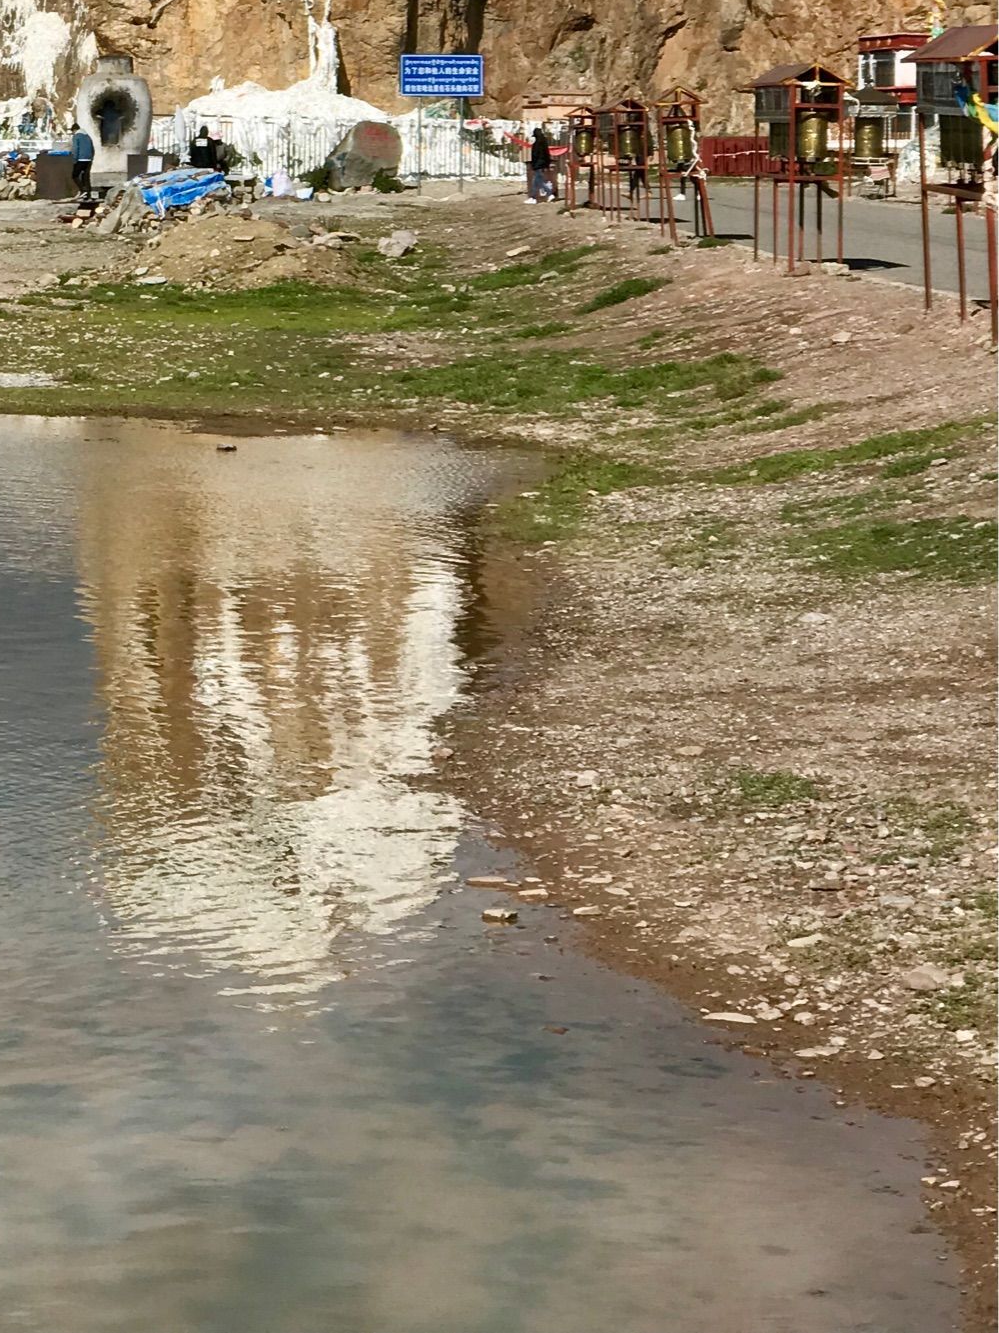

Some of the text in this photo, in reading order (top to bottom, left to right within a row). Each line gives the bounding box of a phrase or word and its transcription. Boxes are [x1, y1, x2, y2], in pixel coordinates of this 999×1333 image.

[404, 67, 479, 75] 为了您和他人的生命安全
